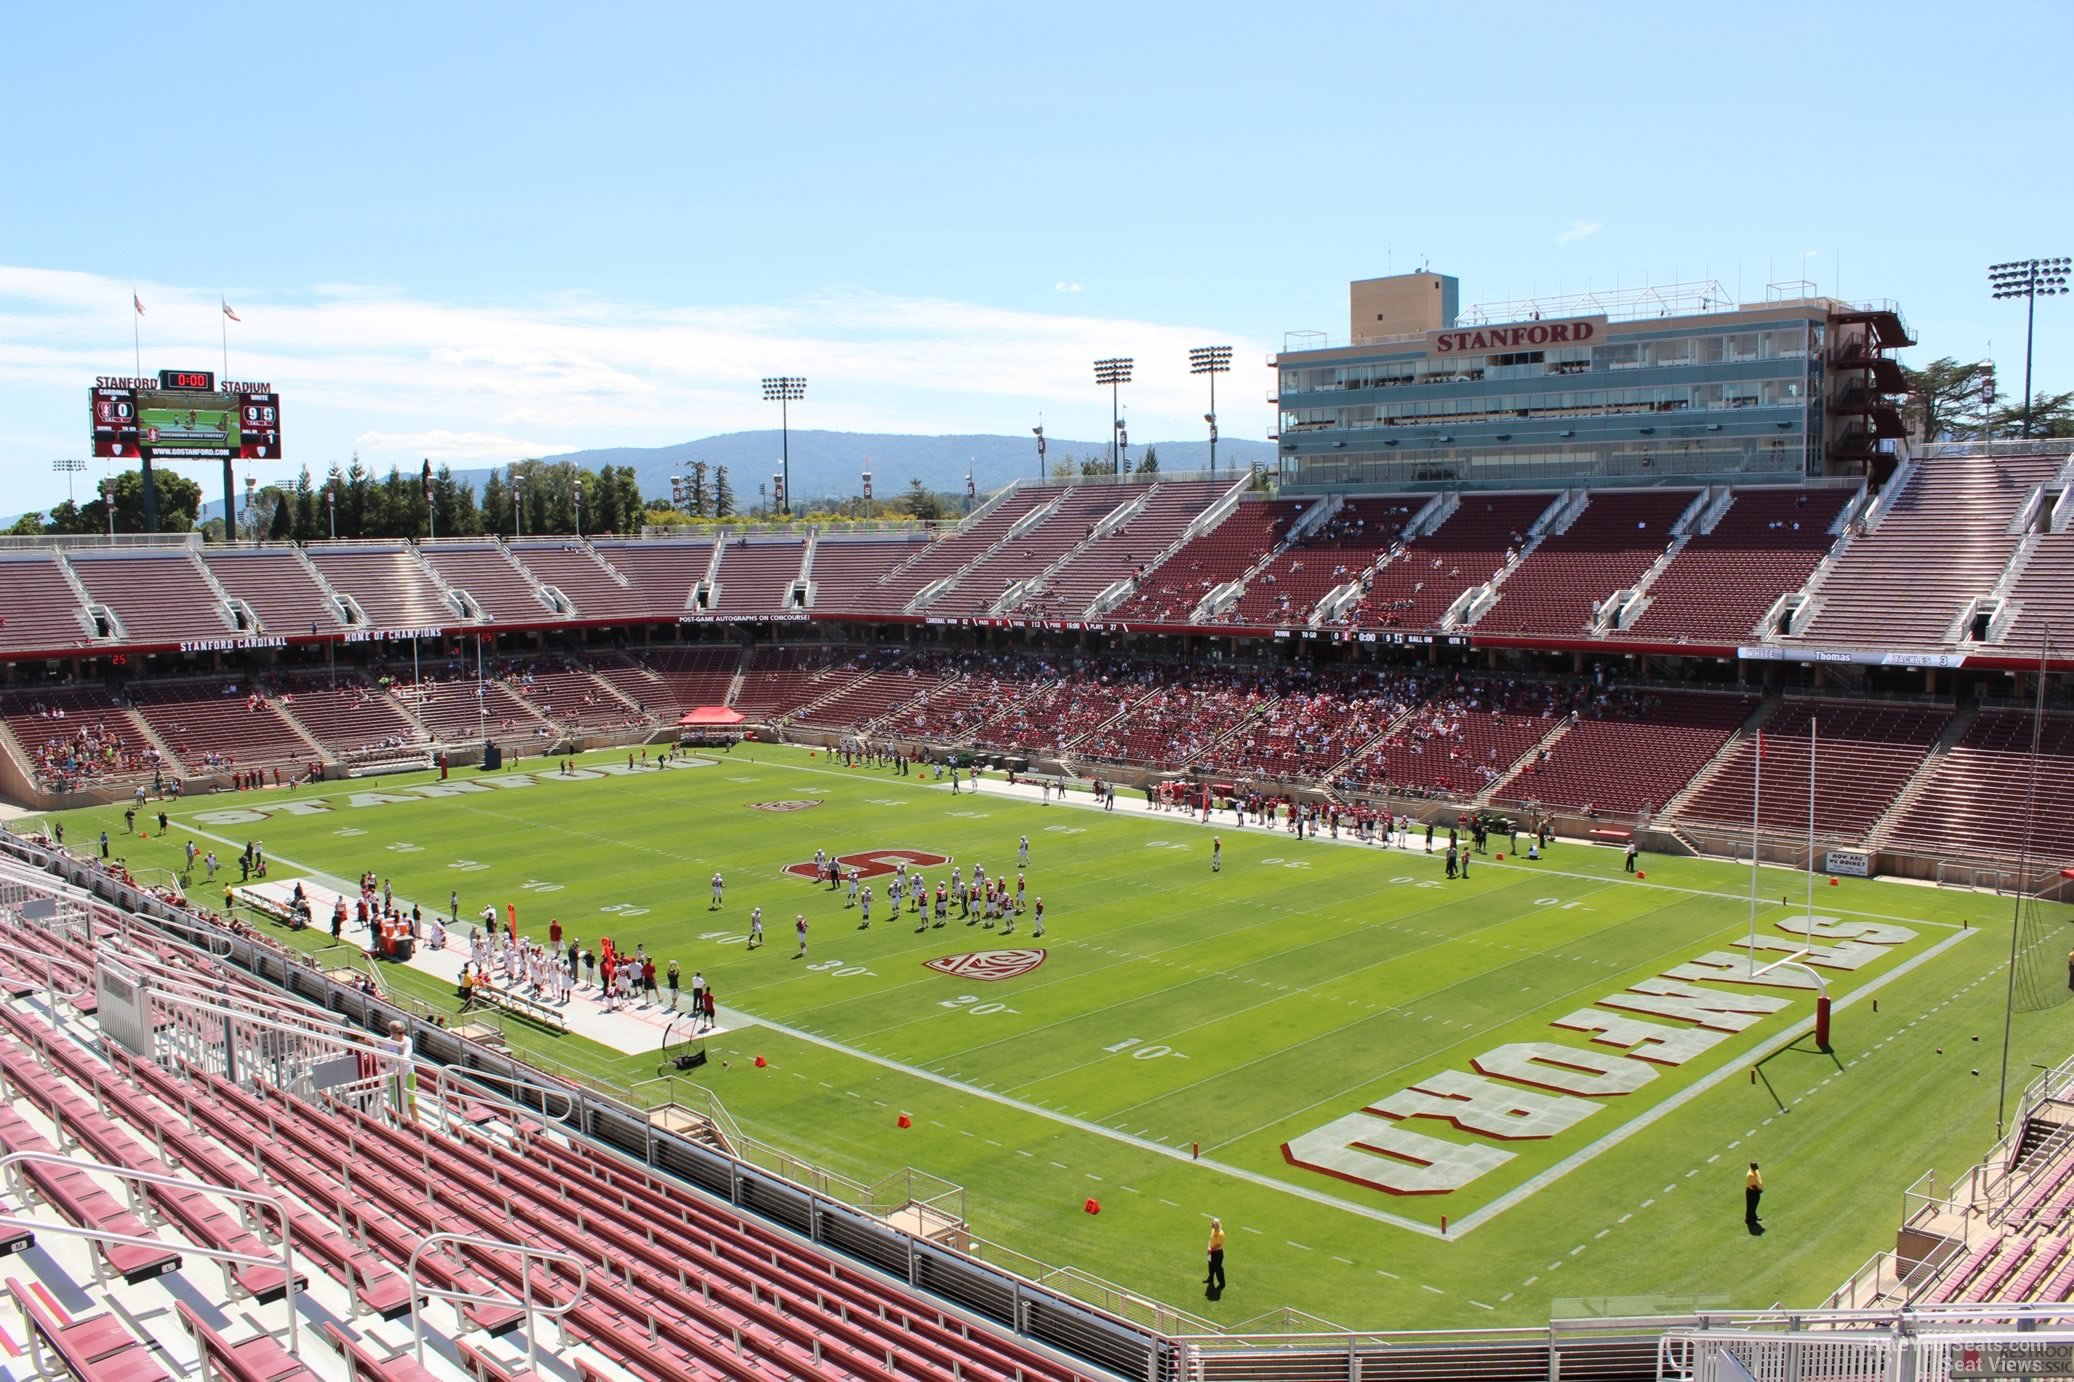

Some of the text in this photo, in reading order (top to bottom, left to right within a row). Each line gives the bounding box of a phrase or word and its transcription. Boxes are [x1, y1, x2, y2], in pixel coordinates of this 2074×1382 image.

[1437, 322, 1594, 352] STANFORD
[96, 376, 159, 390] STANFORD
[178, 374, 205, 387] 0:00
[99, 389, 129, 397] CARDINAL
[221, 381, 271, 394] STADIUM
[118, 404, 128, 417] 0
[248, 407, 258, 420] 9
[268, 434, 274, 444] 1
[152, 448, 229, 456] WWW.GOSTANFORD.COM
[345, 628, 442, 643] HOME OF CHAMPIONS
[1334, 632, 1339, 640] 0
[1359, 633, 1375, 642] 0:00
[1408, 635, 1423, 643] BALL
[1448, 637, 1460, 645] QTR
[180, 636, 287, 652] STANFORD CARDINAL
[112, 654, 127, 665] 25
[1747, 649, 1774, 658] WHITE
[1815, 651, 1850, 662] Thomas
[1939, 656, 1947, 666] 3
[600, 903, 650, 917] 50
[697, 931, 748, 945] 40
[806, 960, 868, 977] 30
[936, 995, 1006, 1015] 20
[1102, 1038, 1172, 1060] 10
[1280, 915, 1919, 1196] STANFORD
[15, 1242, 23, 1251] M
[2002, 1345, 2072, 1358] RESTROO
